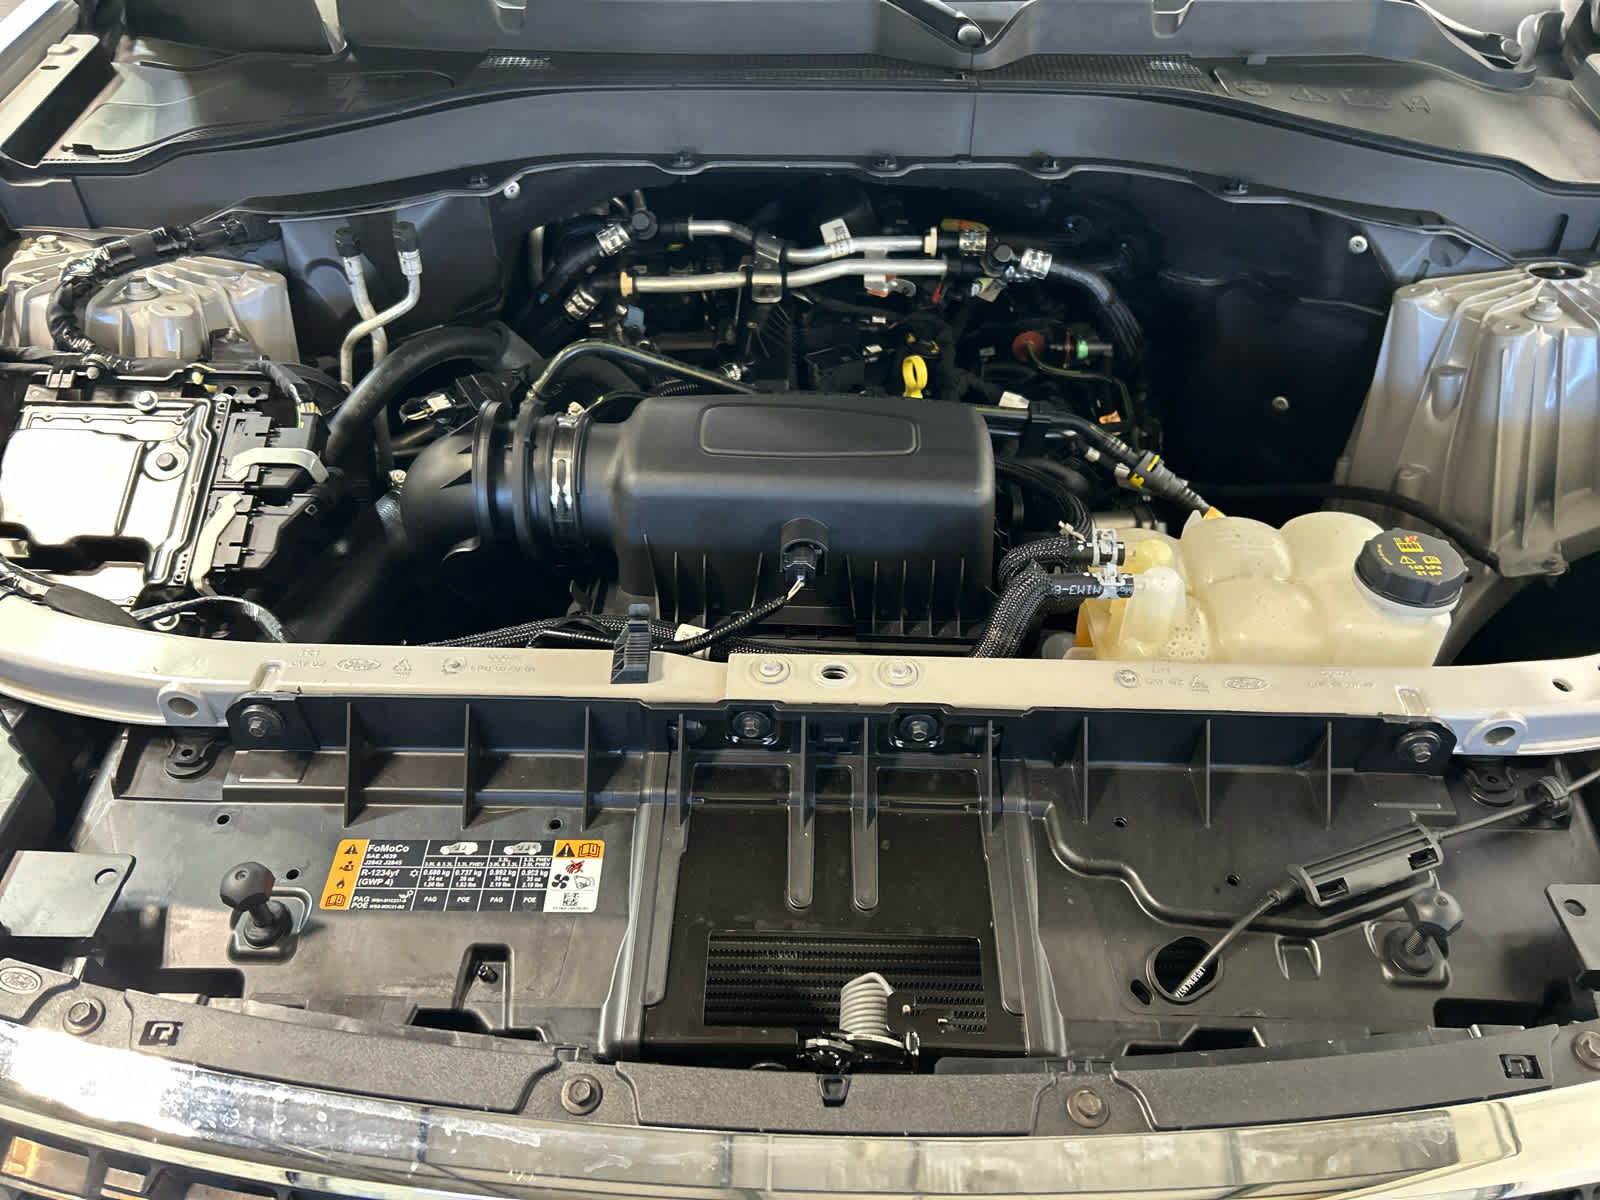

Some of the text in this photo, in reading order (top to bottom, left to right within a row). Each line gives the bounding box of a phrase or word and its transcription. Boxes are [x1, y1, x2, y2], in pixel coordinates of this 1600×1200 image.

[368, 844, 409, 853] FoMoCo
[361, 868, 400, 878] R-1234yf
[442, 869, 451, 877] kg
[473, 869, 482, 877] kg
[507, 869, 517, 877] kg
[540, 869, 549, 877] kg
[358, 878, 394, 887] (GWP 4)
[353, 895, 370, 903] PAG
